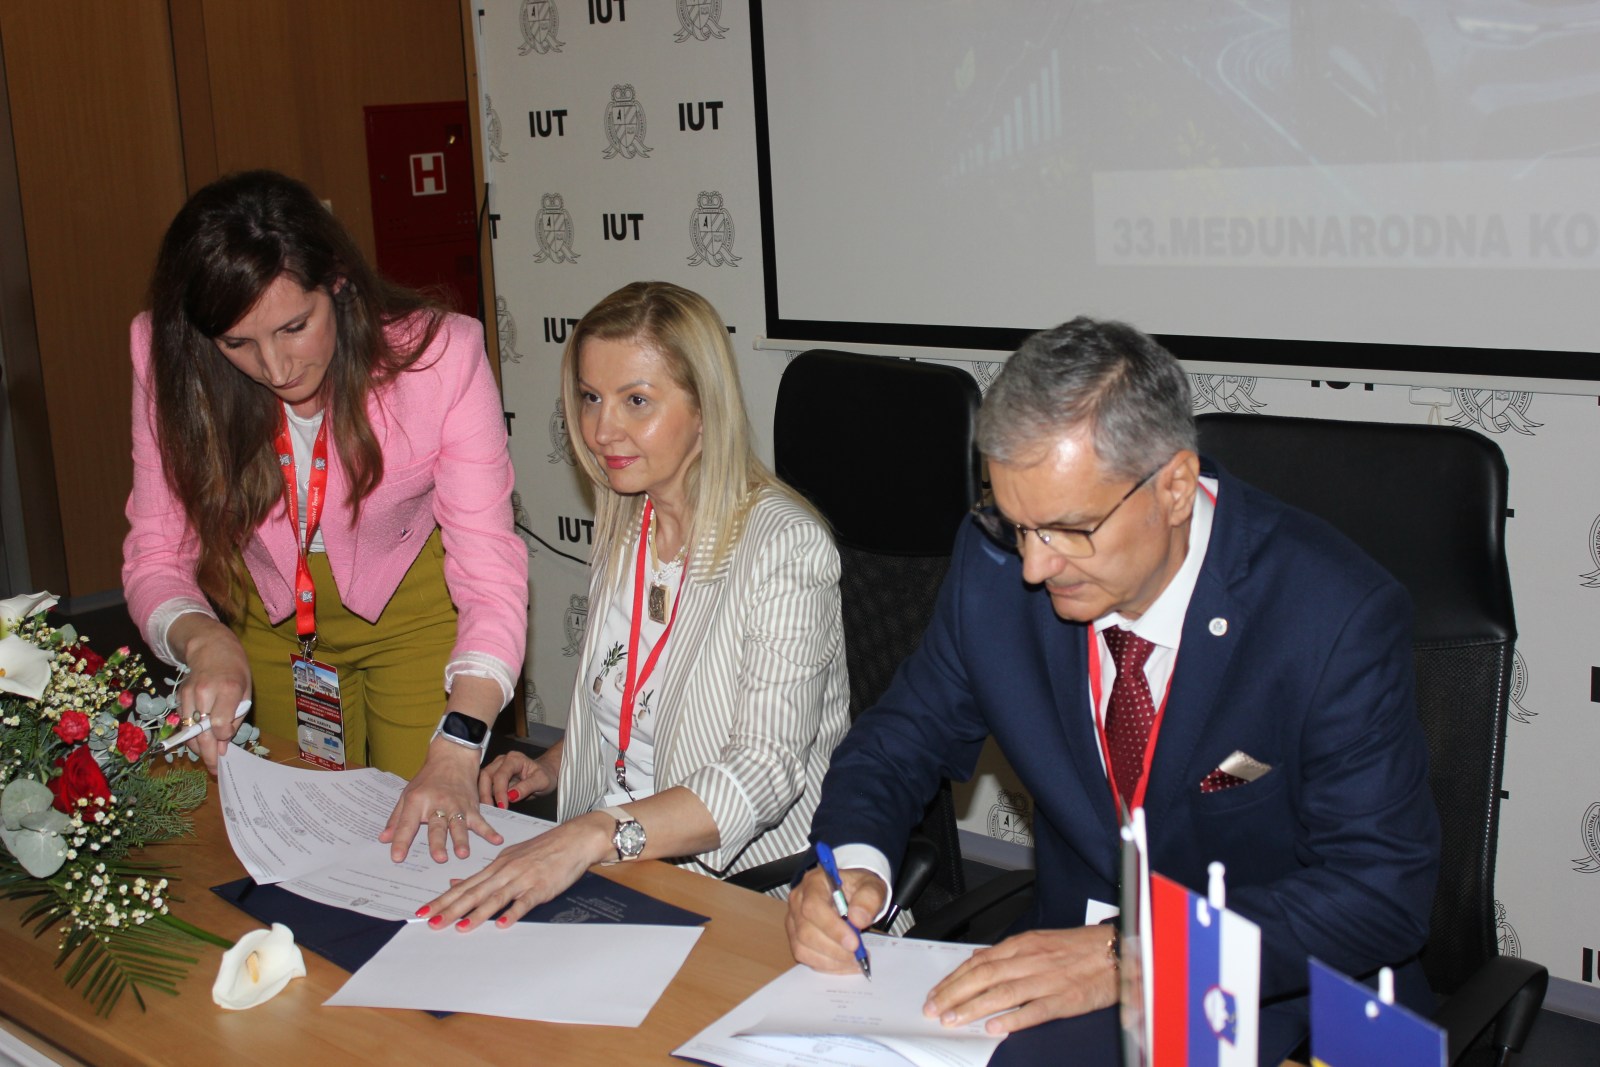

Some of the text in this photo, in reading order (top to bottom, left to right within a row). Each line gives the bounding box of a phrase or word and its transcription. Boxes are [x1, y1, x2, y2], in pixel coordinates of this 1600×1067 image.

[588, 0, 626, 24] IUT
[529, 109, 568, 137] IUT
[678, 101, 723, 131] IUT
[602, 213, 644, 240] IUT
[558, 515, 595, 545] IUT
[1514, 660, 1522, 697] UNIVERSITY
